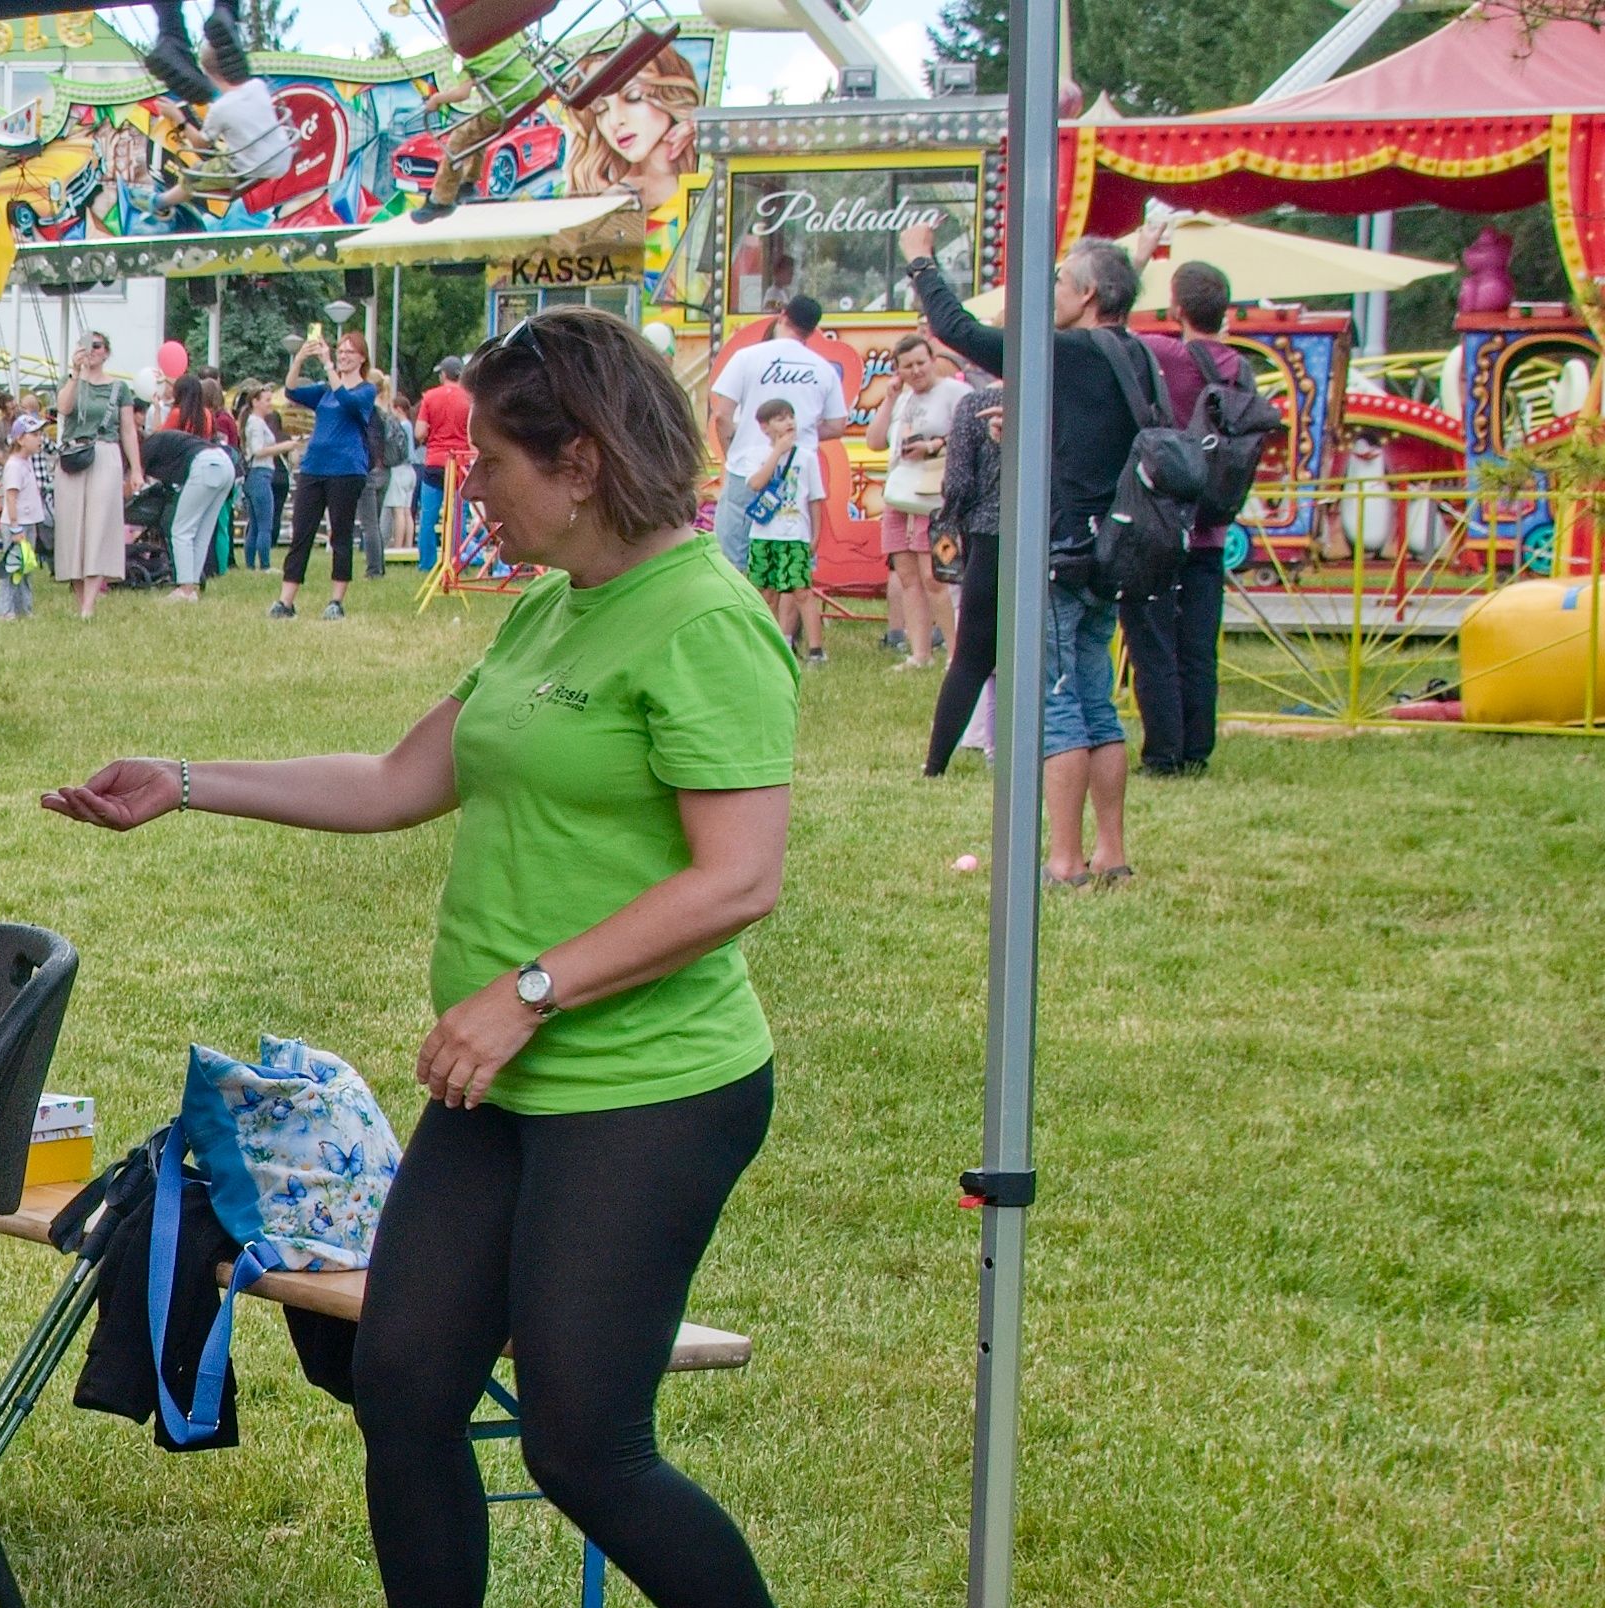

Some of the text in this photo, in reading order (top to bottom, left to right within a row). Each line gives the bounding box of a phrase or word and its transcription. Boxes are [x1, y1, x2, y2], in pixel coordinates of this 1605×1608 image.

[752, 189, 948, 236] Pokladna
[511, 255, 616, 285] KASSA
[760, 357, 819, 385] true.
